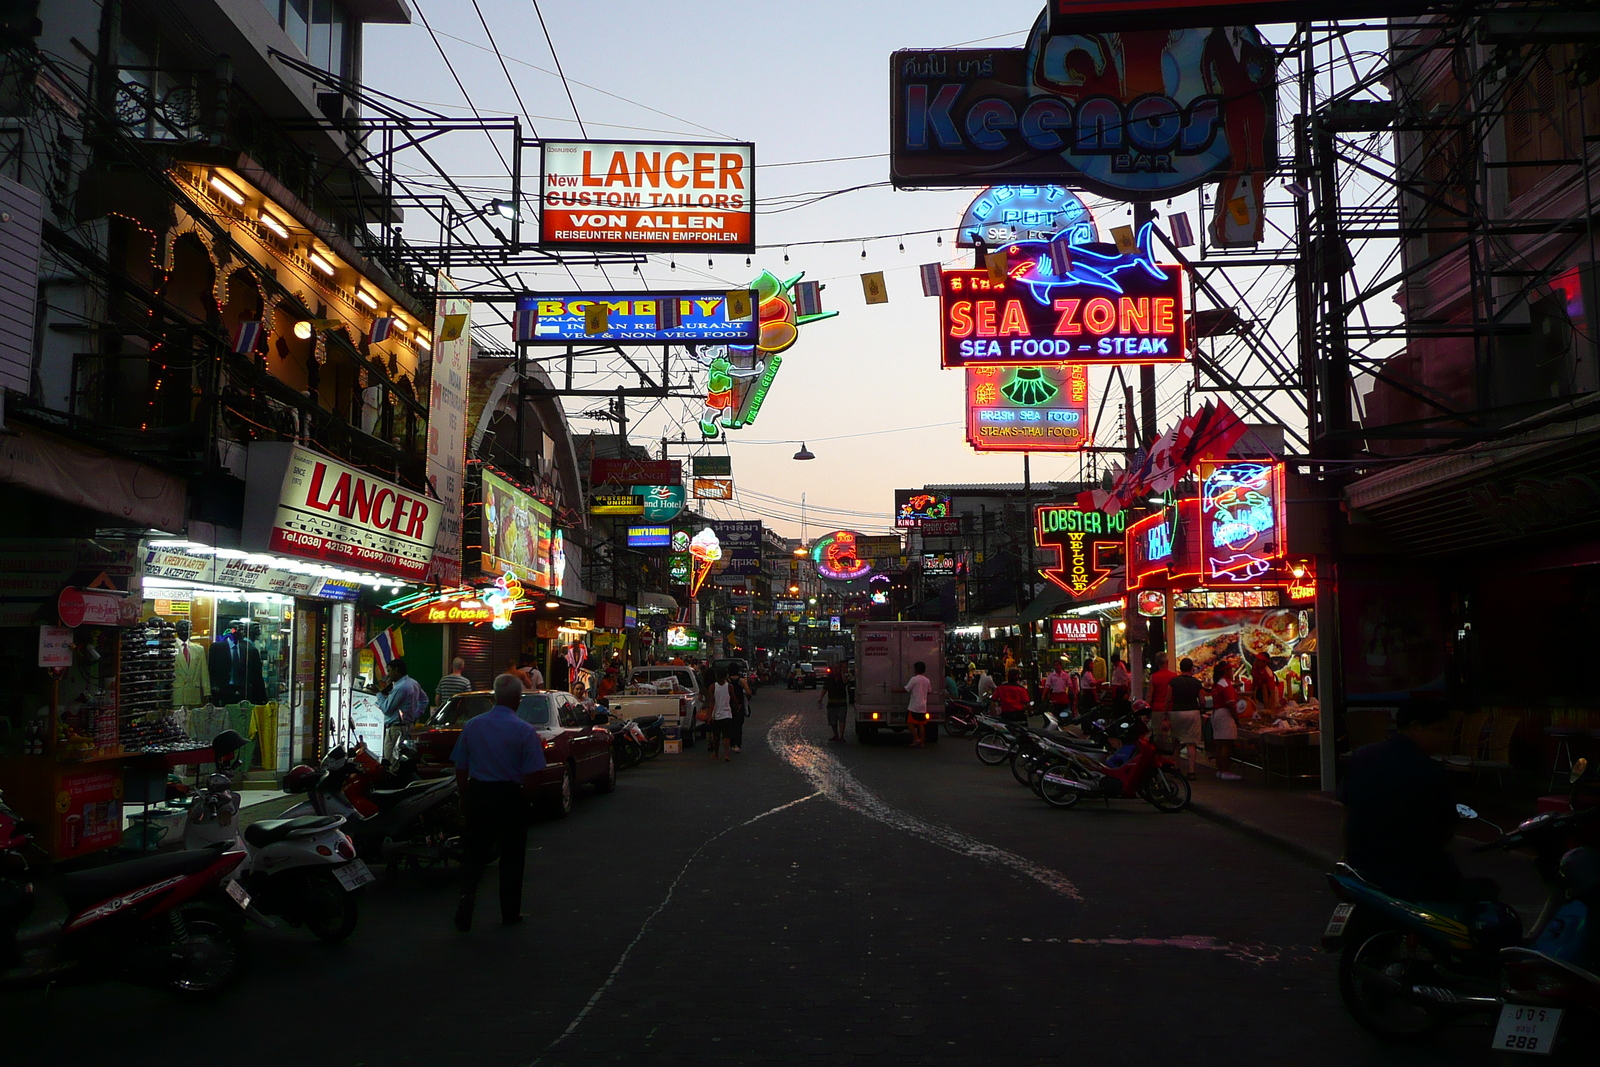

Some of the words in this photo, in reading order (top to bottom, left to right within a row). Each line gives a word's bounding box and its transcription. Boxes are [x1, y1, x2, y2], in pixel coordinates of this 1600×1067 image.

[905, 83, 1219, 152] Keenos
[547, 173, 578, 187] New
[581, 150, 745, 190] LANCER
[1113, 154, 1176, 169] BAR
[546, 191, 641, 207] CUSTOM
[649, 192, 744, 209] TAILORS
[569, 214, 627, 228] VON
[636, 215, 724, 229] ALLEN
[1002, 209, 1058, 226] POT
[555, 230, 622, 241] REISEUNTER
[625, 231, 670, 241] NEHMEN
[673, 231, 738, 242] EMPFOHLEN
[537, 299, 724, 317] BOMBY
[950, 300, 1030, 337] SEA
[1053, 297, 1174, 335] ZONE
[563, 331, 595, 339] VEG
[620, 331, 657, 339] NON
[664, 330, 696, 338] VEG
[700, 330, 749, 338] FOOD
[960, 339, 1001, 356] SEA
[1010, 339, 1070, 356] FOOD
[1097, 337, 1168, 355] STEAK
[745, 389, 765, 425] ITALIAN
[762, 355, 783, 387] GELATO
[1019, 411, 1041, 420] SEA
[1047, 411, 1079, 421] FOOD
[1047, 427, 1079, 437] FOOD
[305, 461, 429, 541] LANCER
[660, 500, 682, 508] Hotel
[897, 519, 915, 527] KING
[1042, 509, 1102, 534] LOBSTER
[1107, 510, 1127, 533] PO
[285, 521, 363, 546] CUSTOM
[369, 541, 428, 561] TAILORS
[296, 513, 359, 536] LADIES
[380, 537, 422, 552] GENTS
[1068, 533, 1088, 591] WELCOME
[164, 567, 200, 579] AKZEPTIERT
[428, 607, 446, 620] Ice
[448, 606, 489, 620] Cream
[1055, 622, 1098, 635] AMARIO
[1505, 1034, 1539, 1050] 288
